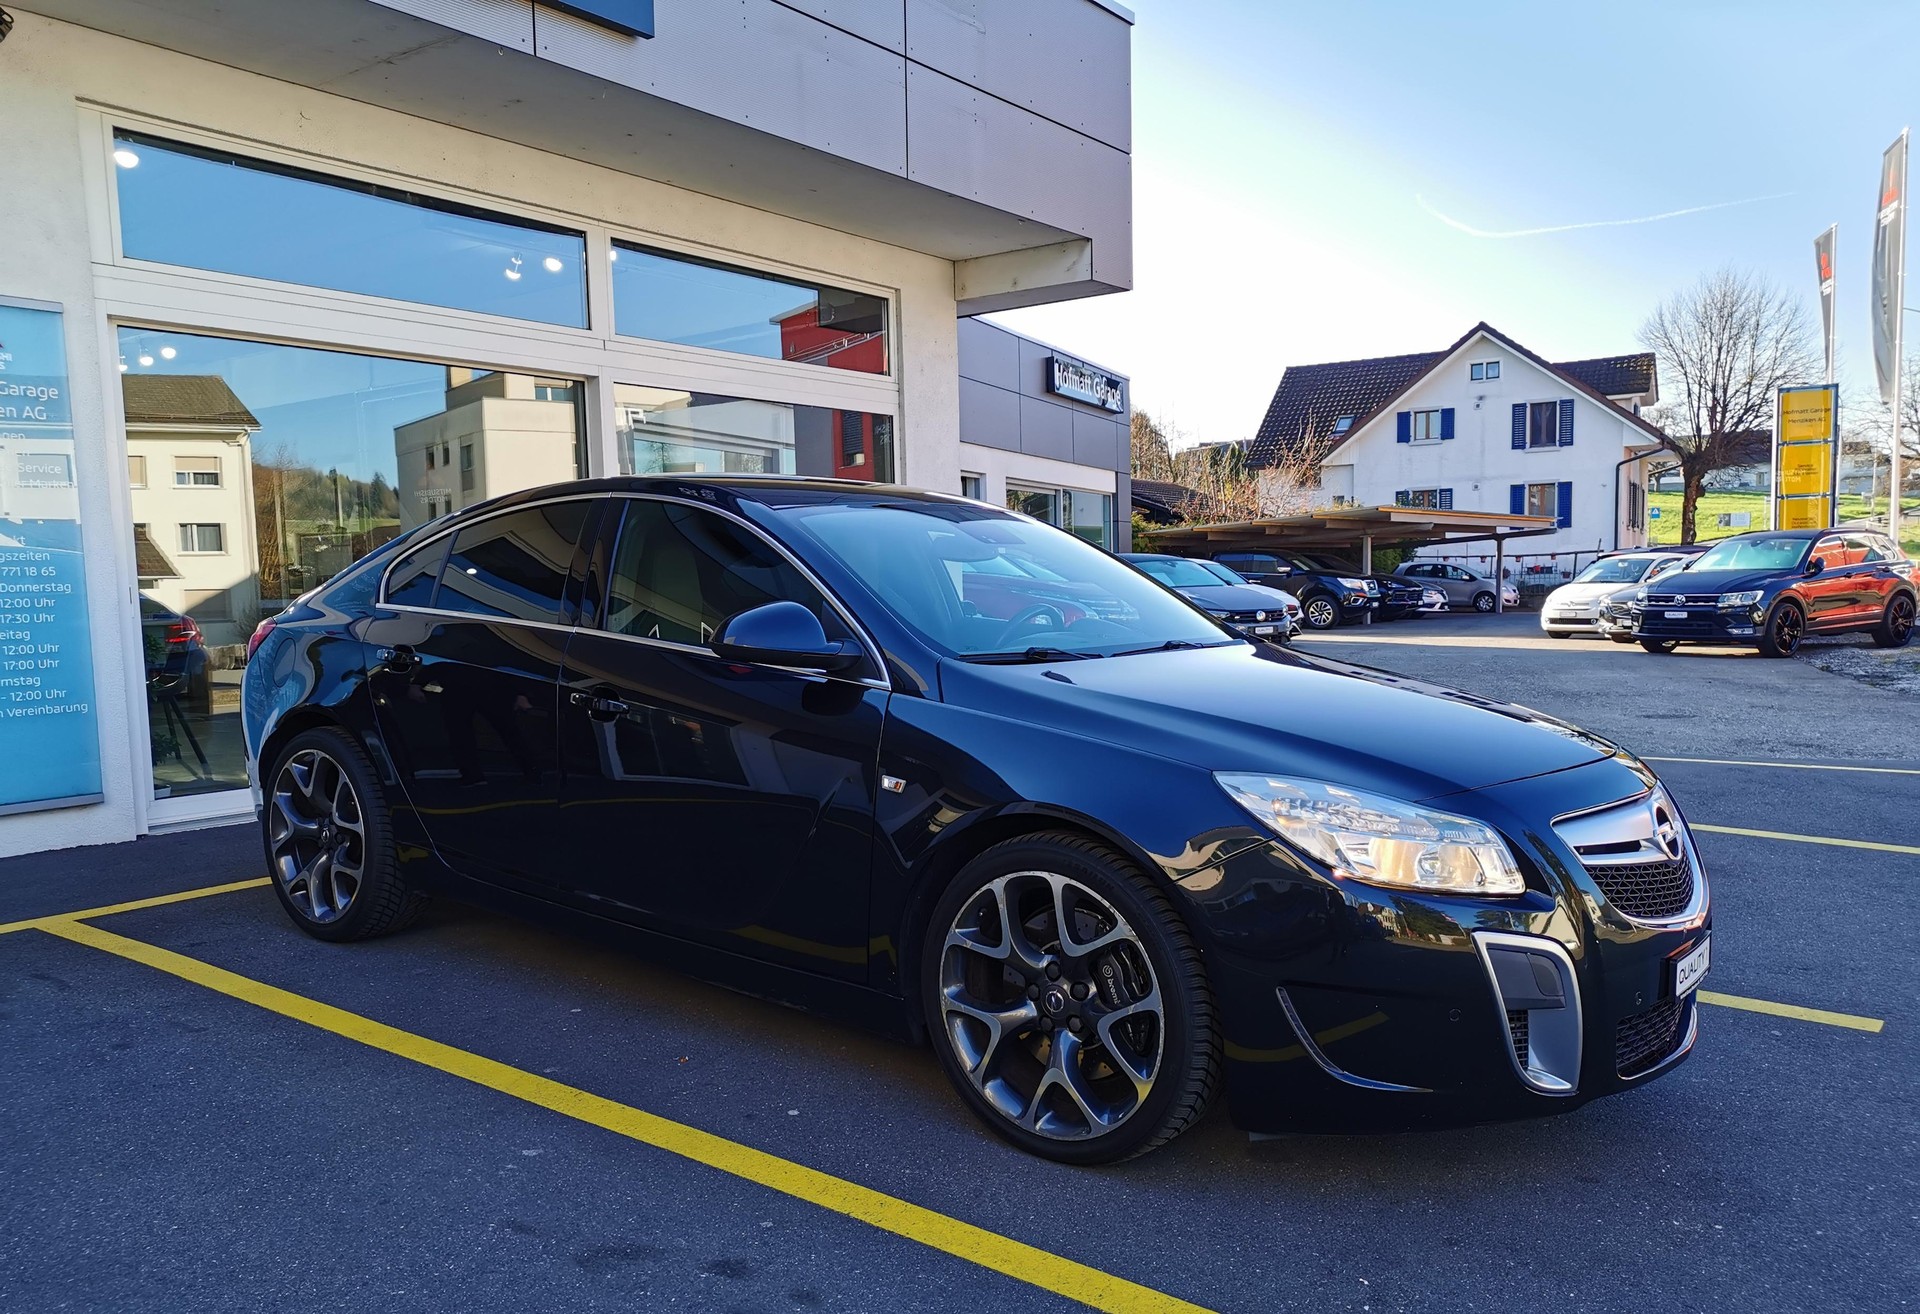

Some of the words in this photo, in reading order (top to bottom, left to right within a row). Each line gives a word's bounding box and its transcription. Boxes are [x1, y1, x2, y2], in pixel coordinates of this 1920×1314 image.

[23, 406, 47, 420] AG
[18, 463, 62, 474] Service
[1, 567, 21, 576] 771
[24, 567, 37, 576] 18
[41, 566, 56, 576] 65
[0, 583, 71, 594] Donnerstag
[34, 598, 56, 608] Uhr
[34, 612, 56, 623] Uhr
[2, 645, 35, 655] 12:00
[38, 643, 60, 654] Uhr
[3, 660, 35, 670] 17:00
[38, 659, 60, 669] Uhr
[10, 690, 42, 702] 12:00
[45, 689, 67, 699] Uhr
[6, 703, 88, 717] Vereinbarung
